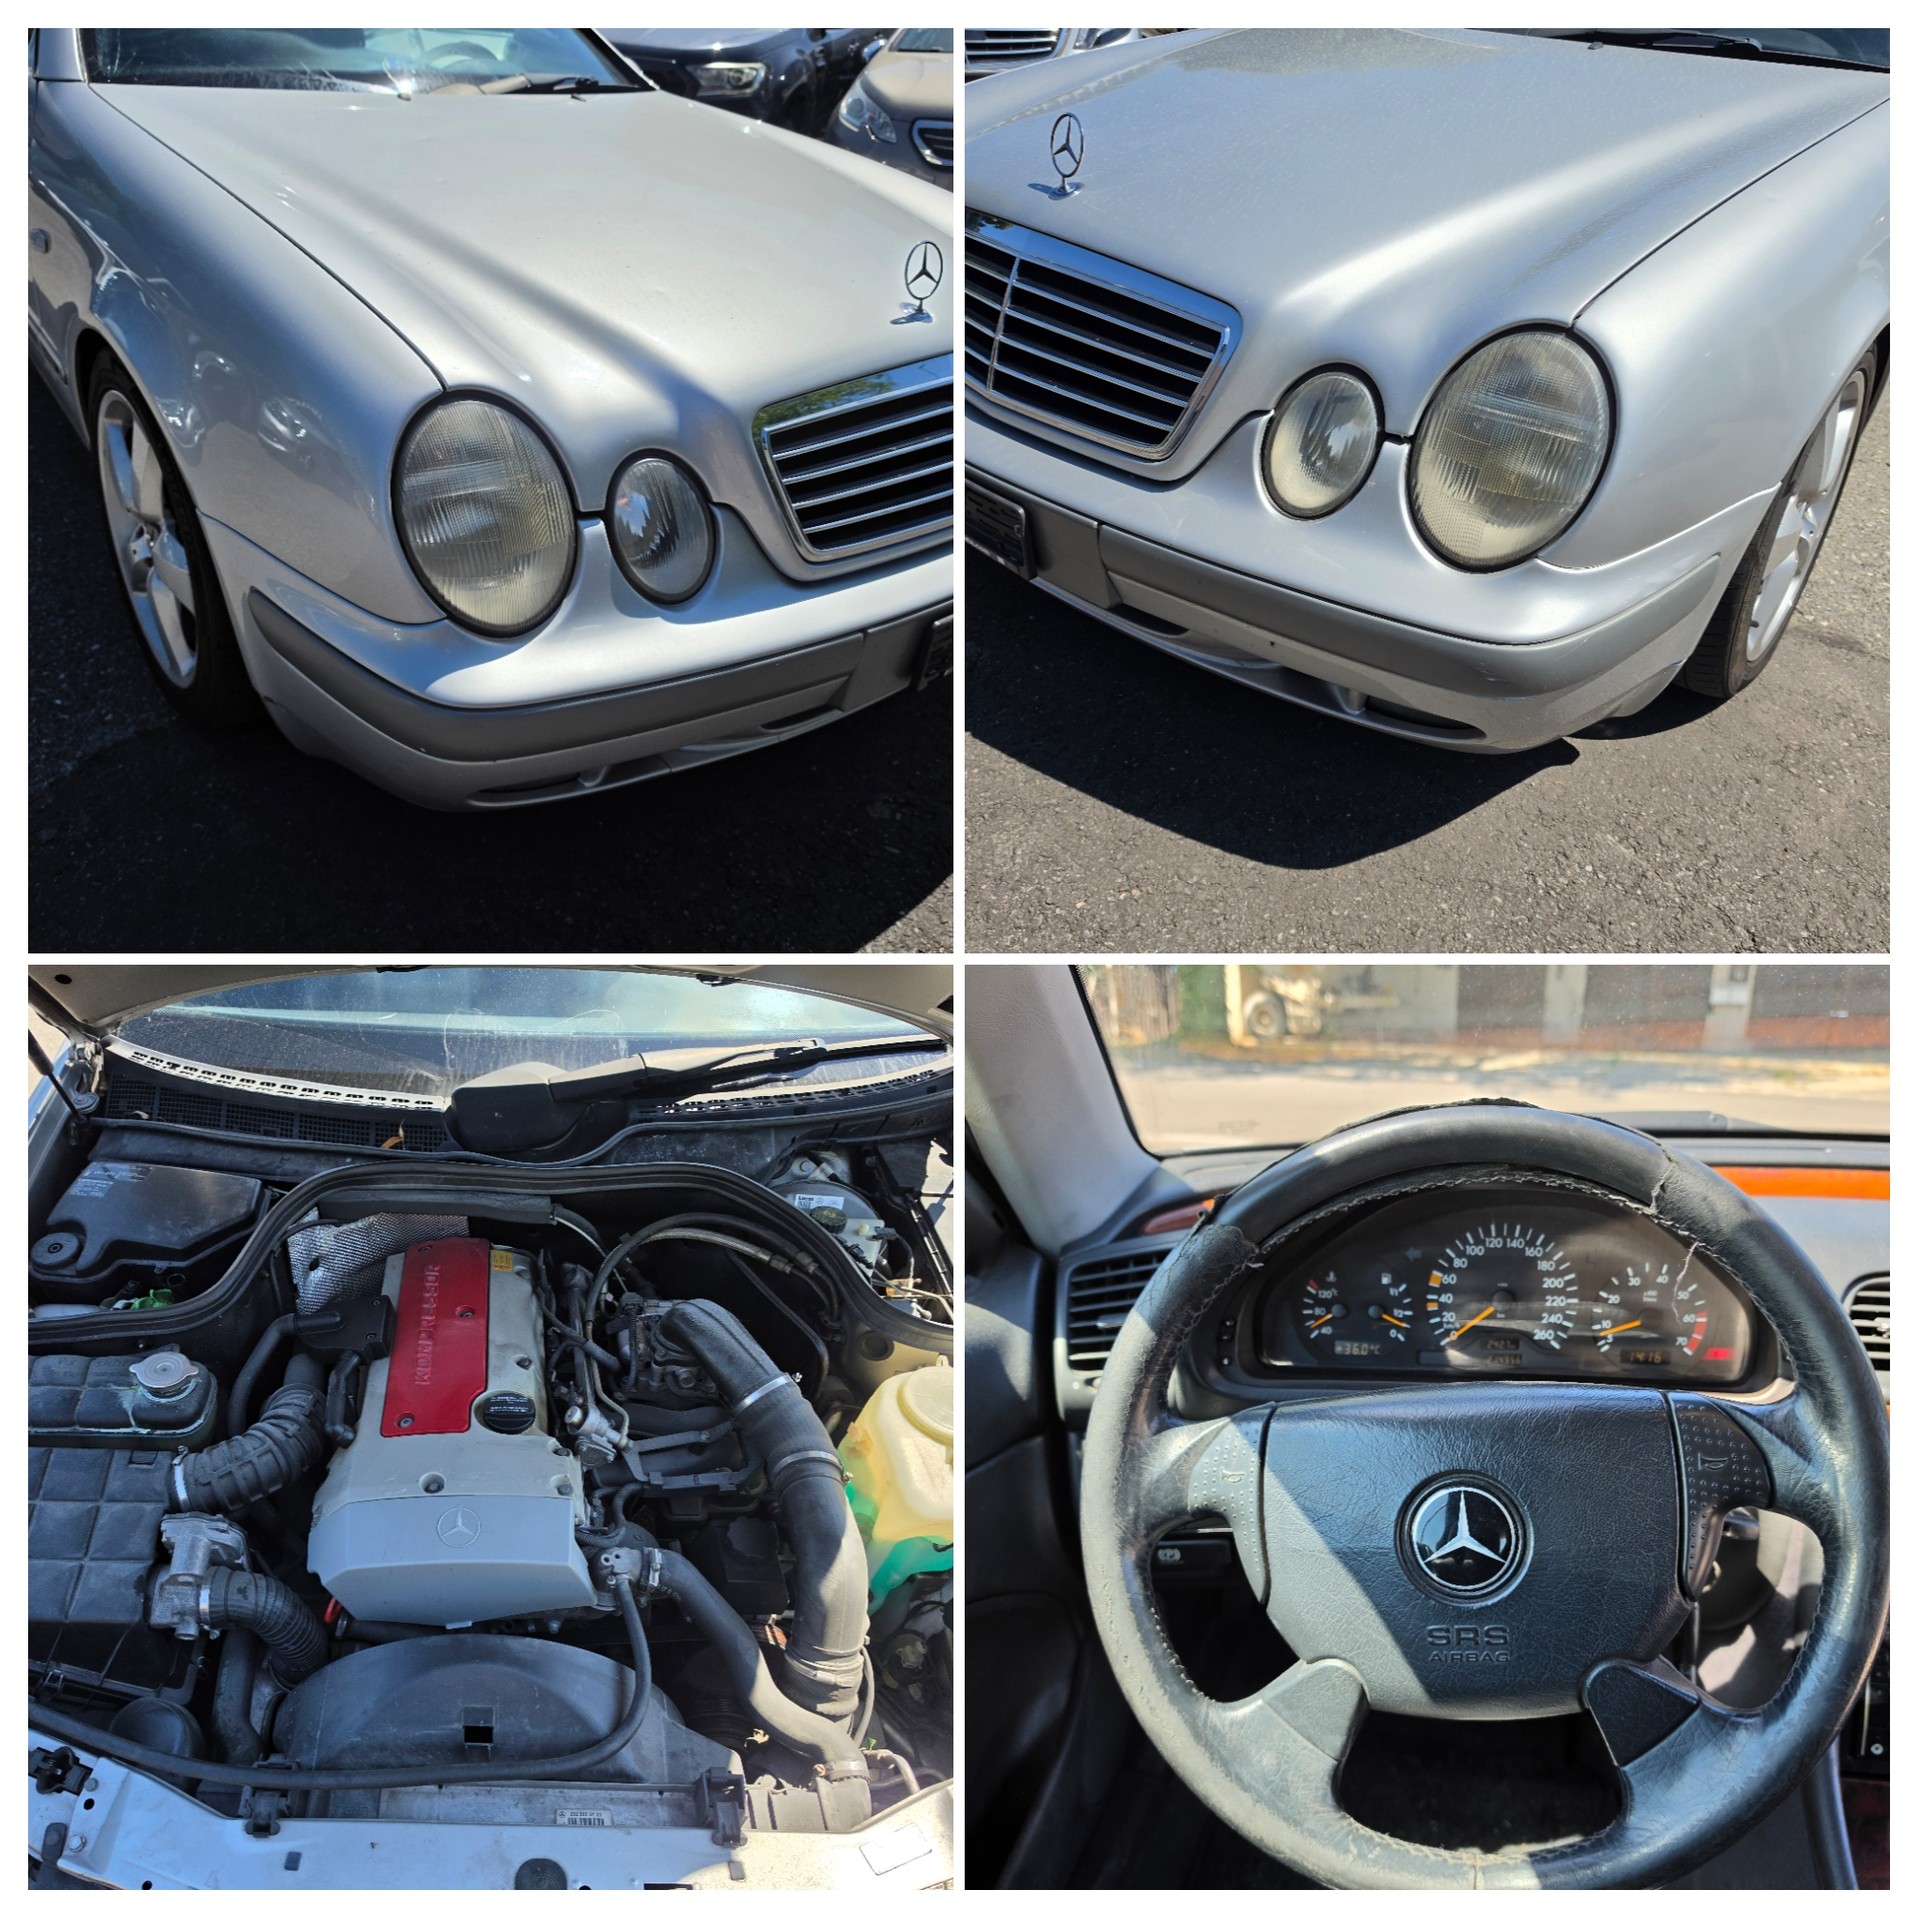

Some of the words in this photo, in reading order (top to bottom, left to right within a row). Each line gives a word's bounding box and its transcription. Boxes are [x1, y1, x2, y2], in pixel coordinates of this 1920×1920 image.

[1485, 1238, 1503, 1248] 120
[1506, 1238, 1525, 1249] 140
[1466, 1245, 1485, 1256] 100
[1525, 1246, 1543, 1257] 160
[1453, 1258, 1468, 1268] 80
[1537, 1261, 1556, 1271] 180
[1442, 1274, 1457, 1284] 60
[1542, 1278, 1564, 1288] 200
[1628, 1277, 1641, 1286] 30
[1656, 1275, 1669, 1284] 40
[1439, 1293, 1453, 1303] 40
[1607, 1294, 1620, 1304] 20
[1677, 1291, 1690, 1300] 50
[1545, 1296, 1566, 1306] 220
[1314, 1306, 1326, 1316] 80
[1442, 1312, 1456, 1322] 20
[1542, 1313, 1563, 1324] 240
[1683, 1313, 1696, 1323] 60
[1601, 1320, 1612, 1329] 10
[1320, 1326, 1332, 1335] 40
[1389, 1328, 1397, 1338] 0
[1533, 1330, 1554, 1340] 260
[1675, 1336, 1688, 1346] 70
[1427, 1625, 1509, 1646] SRS
[1429, 1650, 1510, 1662] AIRBAG
